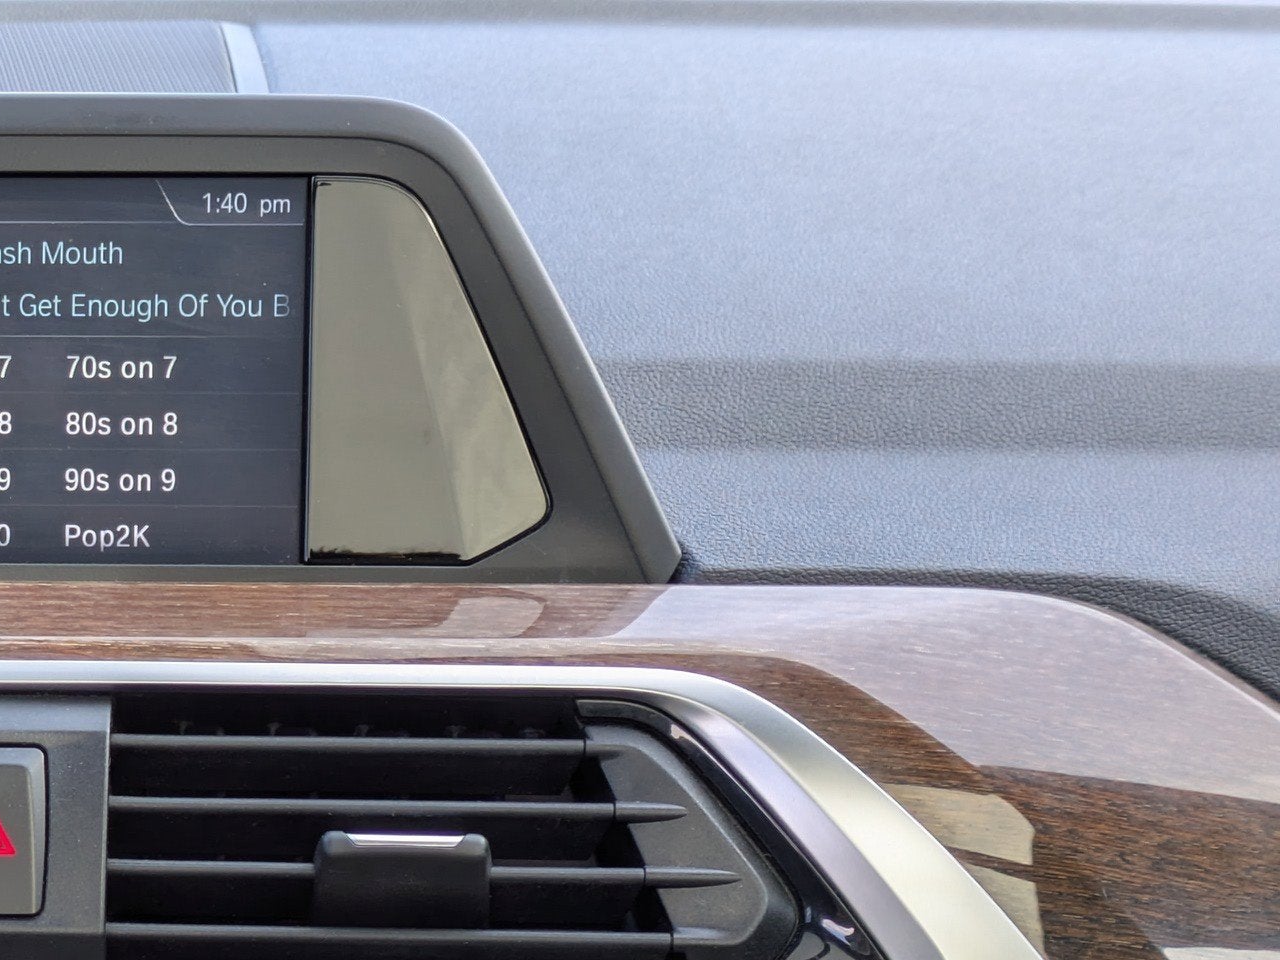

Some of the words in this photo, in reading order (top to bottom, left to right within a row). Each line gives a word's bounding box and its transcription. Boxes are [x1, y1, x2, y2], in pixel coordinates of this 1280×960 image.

[202, 192, 248, 214] 1:40
[260, 198, 291, 218] pm
[42, 241, 123, 265] Mouth
[19, 293, 62, 317] Get
[71, 293, 168, 323] Enough
[178, 293, 209, 318] Of
[216, 293, 262, 318] You
[66, 355, 112, 379] 70s
[121, 360, 153, 379] on
[163, 355, 177, 379] 7
[65, 411, 111, 436] 80s
[120, 417, 153, 436] on
[162, 412, 178, 436] 8
[64, 467, 110, 492] 90s
[119, 473, 151, 492] on
[160, 468, 176, 492] 9
[64, 524, 150, 551] Pop2K
